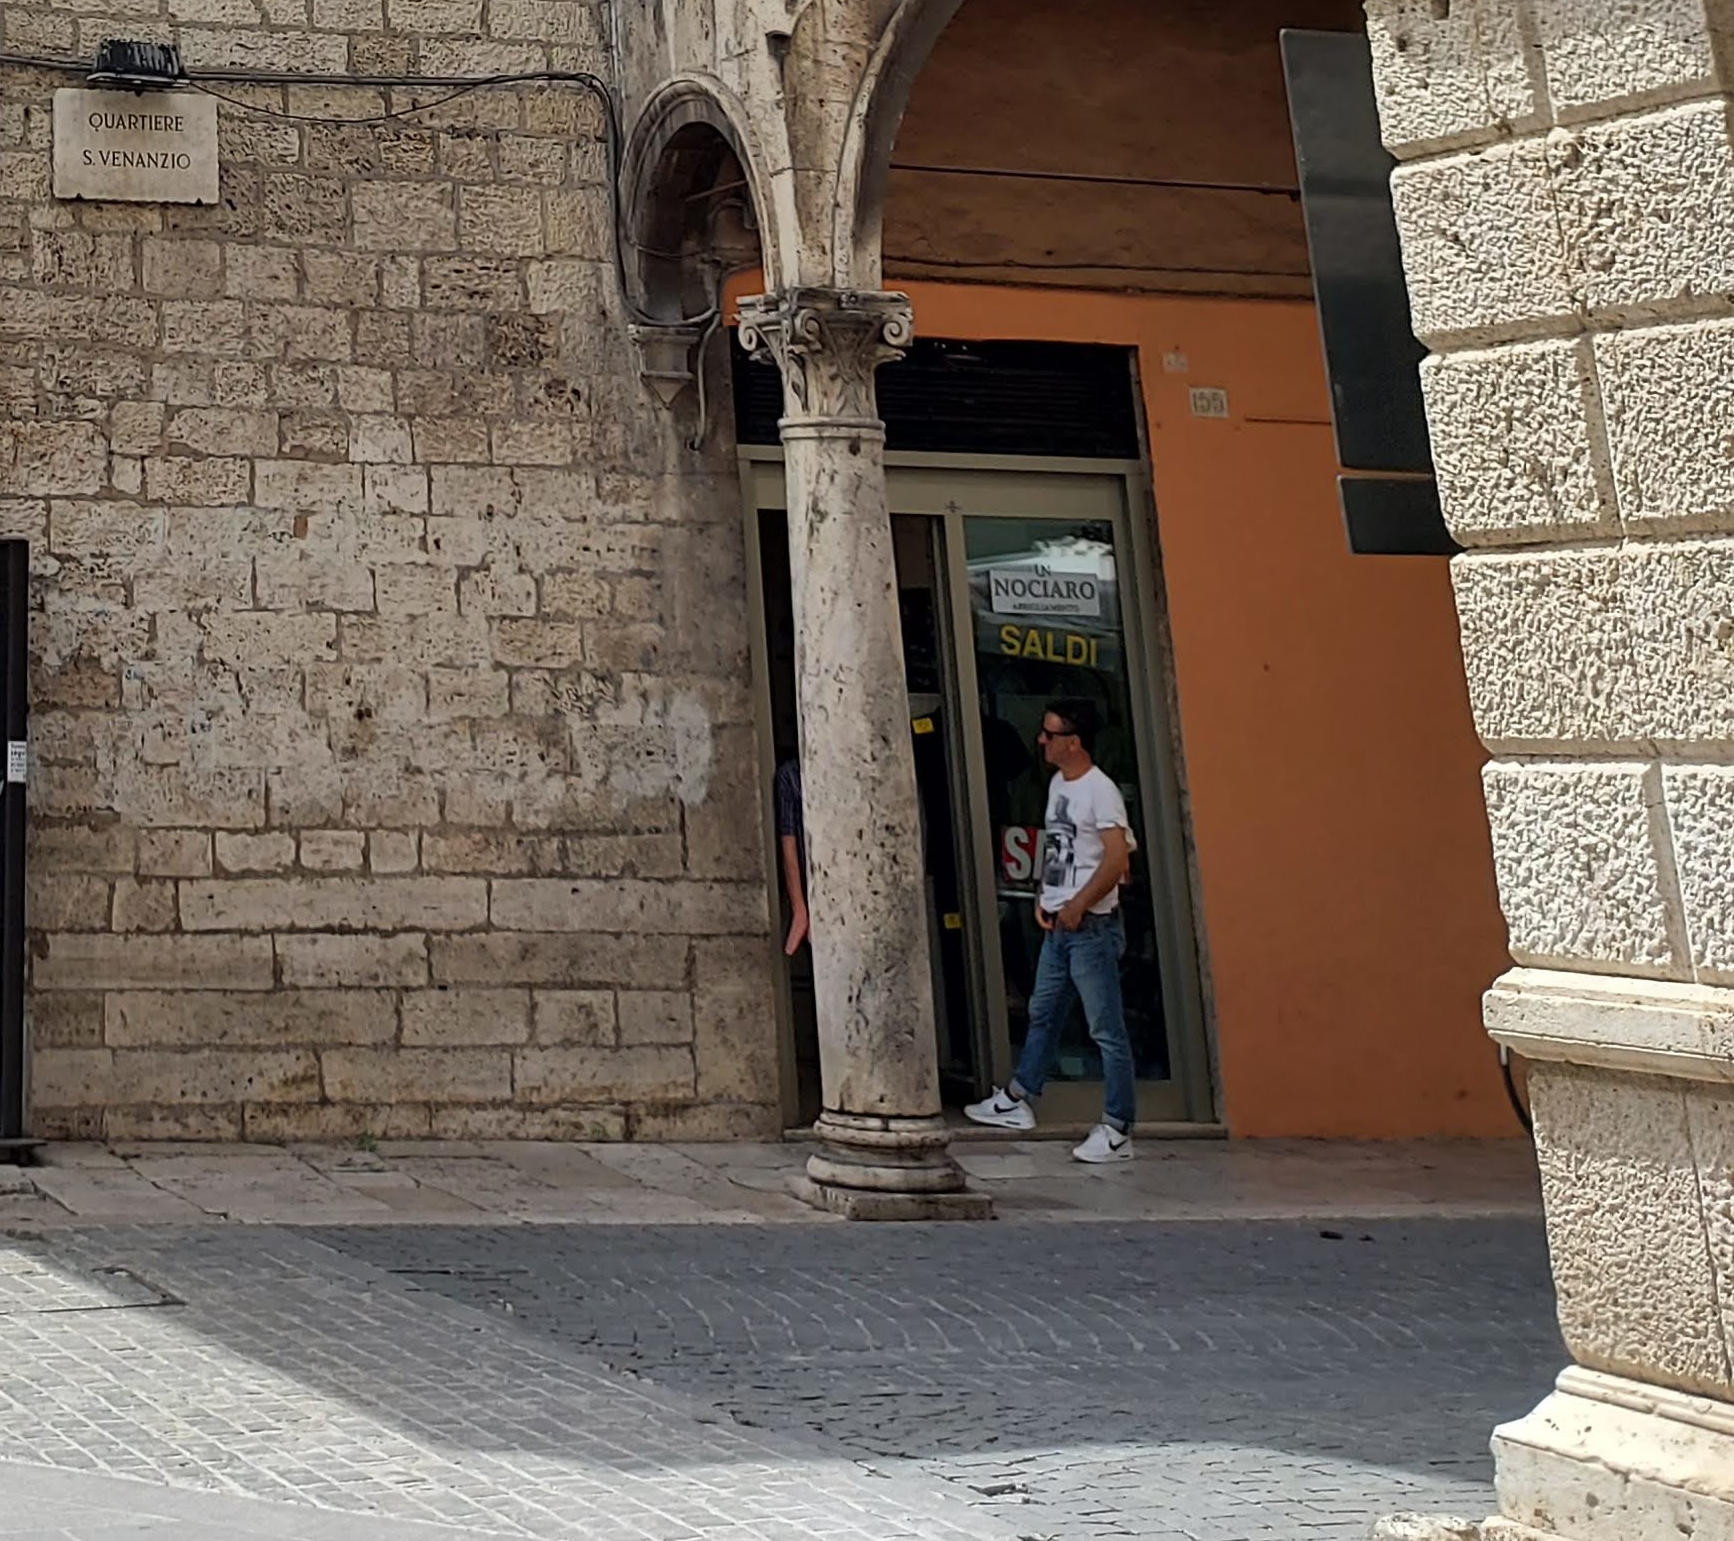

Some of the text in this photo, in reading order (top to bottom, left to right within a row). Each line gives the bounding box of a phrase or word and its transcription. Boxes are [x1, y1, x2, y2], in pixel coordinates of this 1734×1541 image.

[89, 112, 184, 132] QUARTIERE
[82, 149, 191, 170] S. VENANZIO
[994, 578, 1096, 600] NOCIARO
[1000, 624, 1098, 667] SALDI
